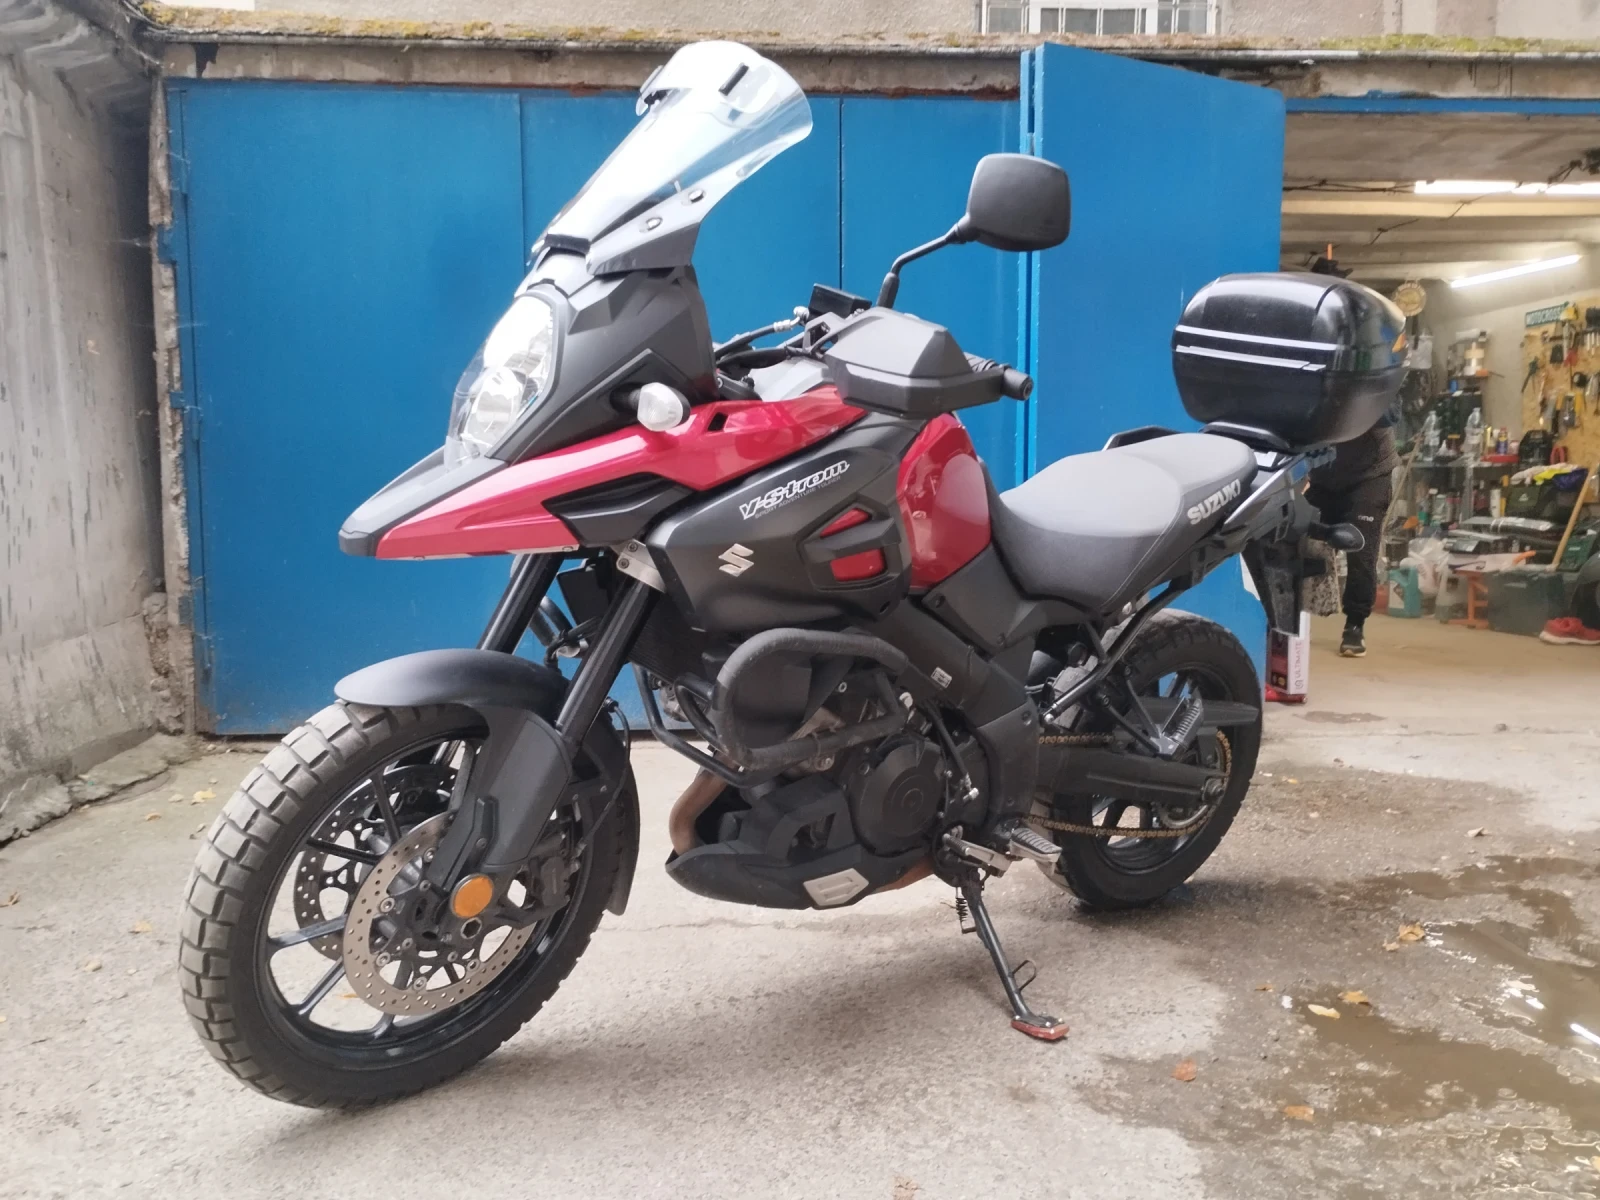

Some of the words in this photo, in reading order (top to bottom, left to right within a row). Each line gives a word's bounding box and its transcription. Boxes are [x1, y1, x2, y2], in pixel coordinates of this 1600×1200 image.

[739, 460, 850, 520] V-Strom
[755, 503, 777, 519] SPORT
[778, 486, 816, 508] ADVENTURE
[818, 475, 841, 489] TOURER
[1187, 479, 1241, 525] SUZUKI
